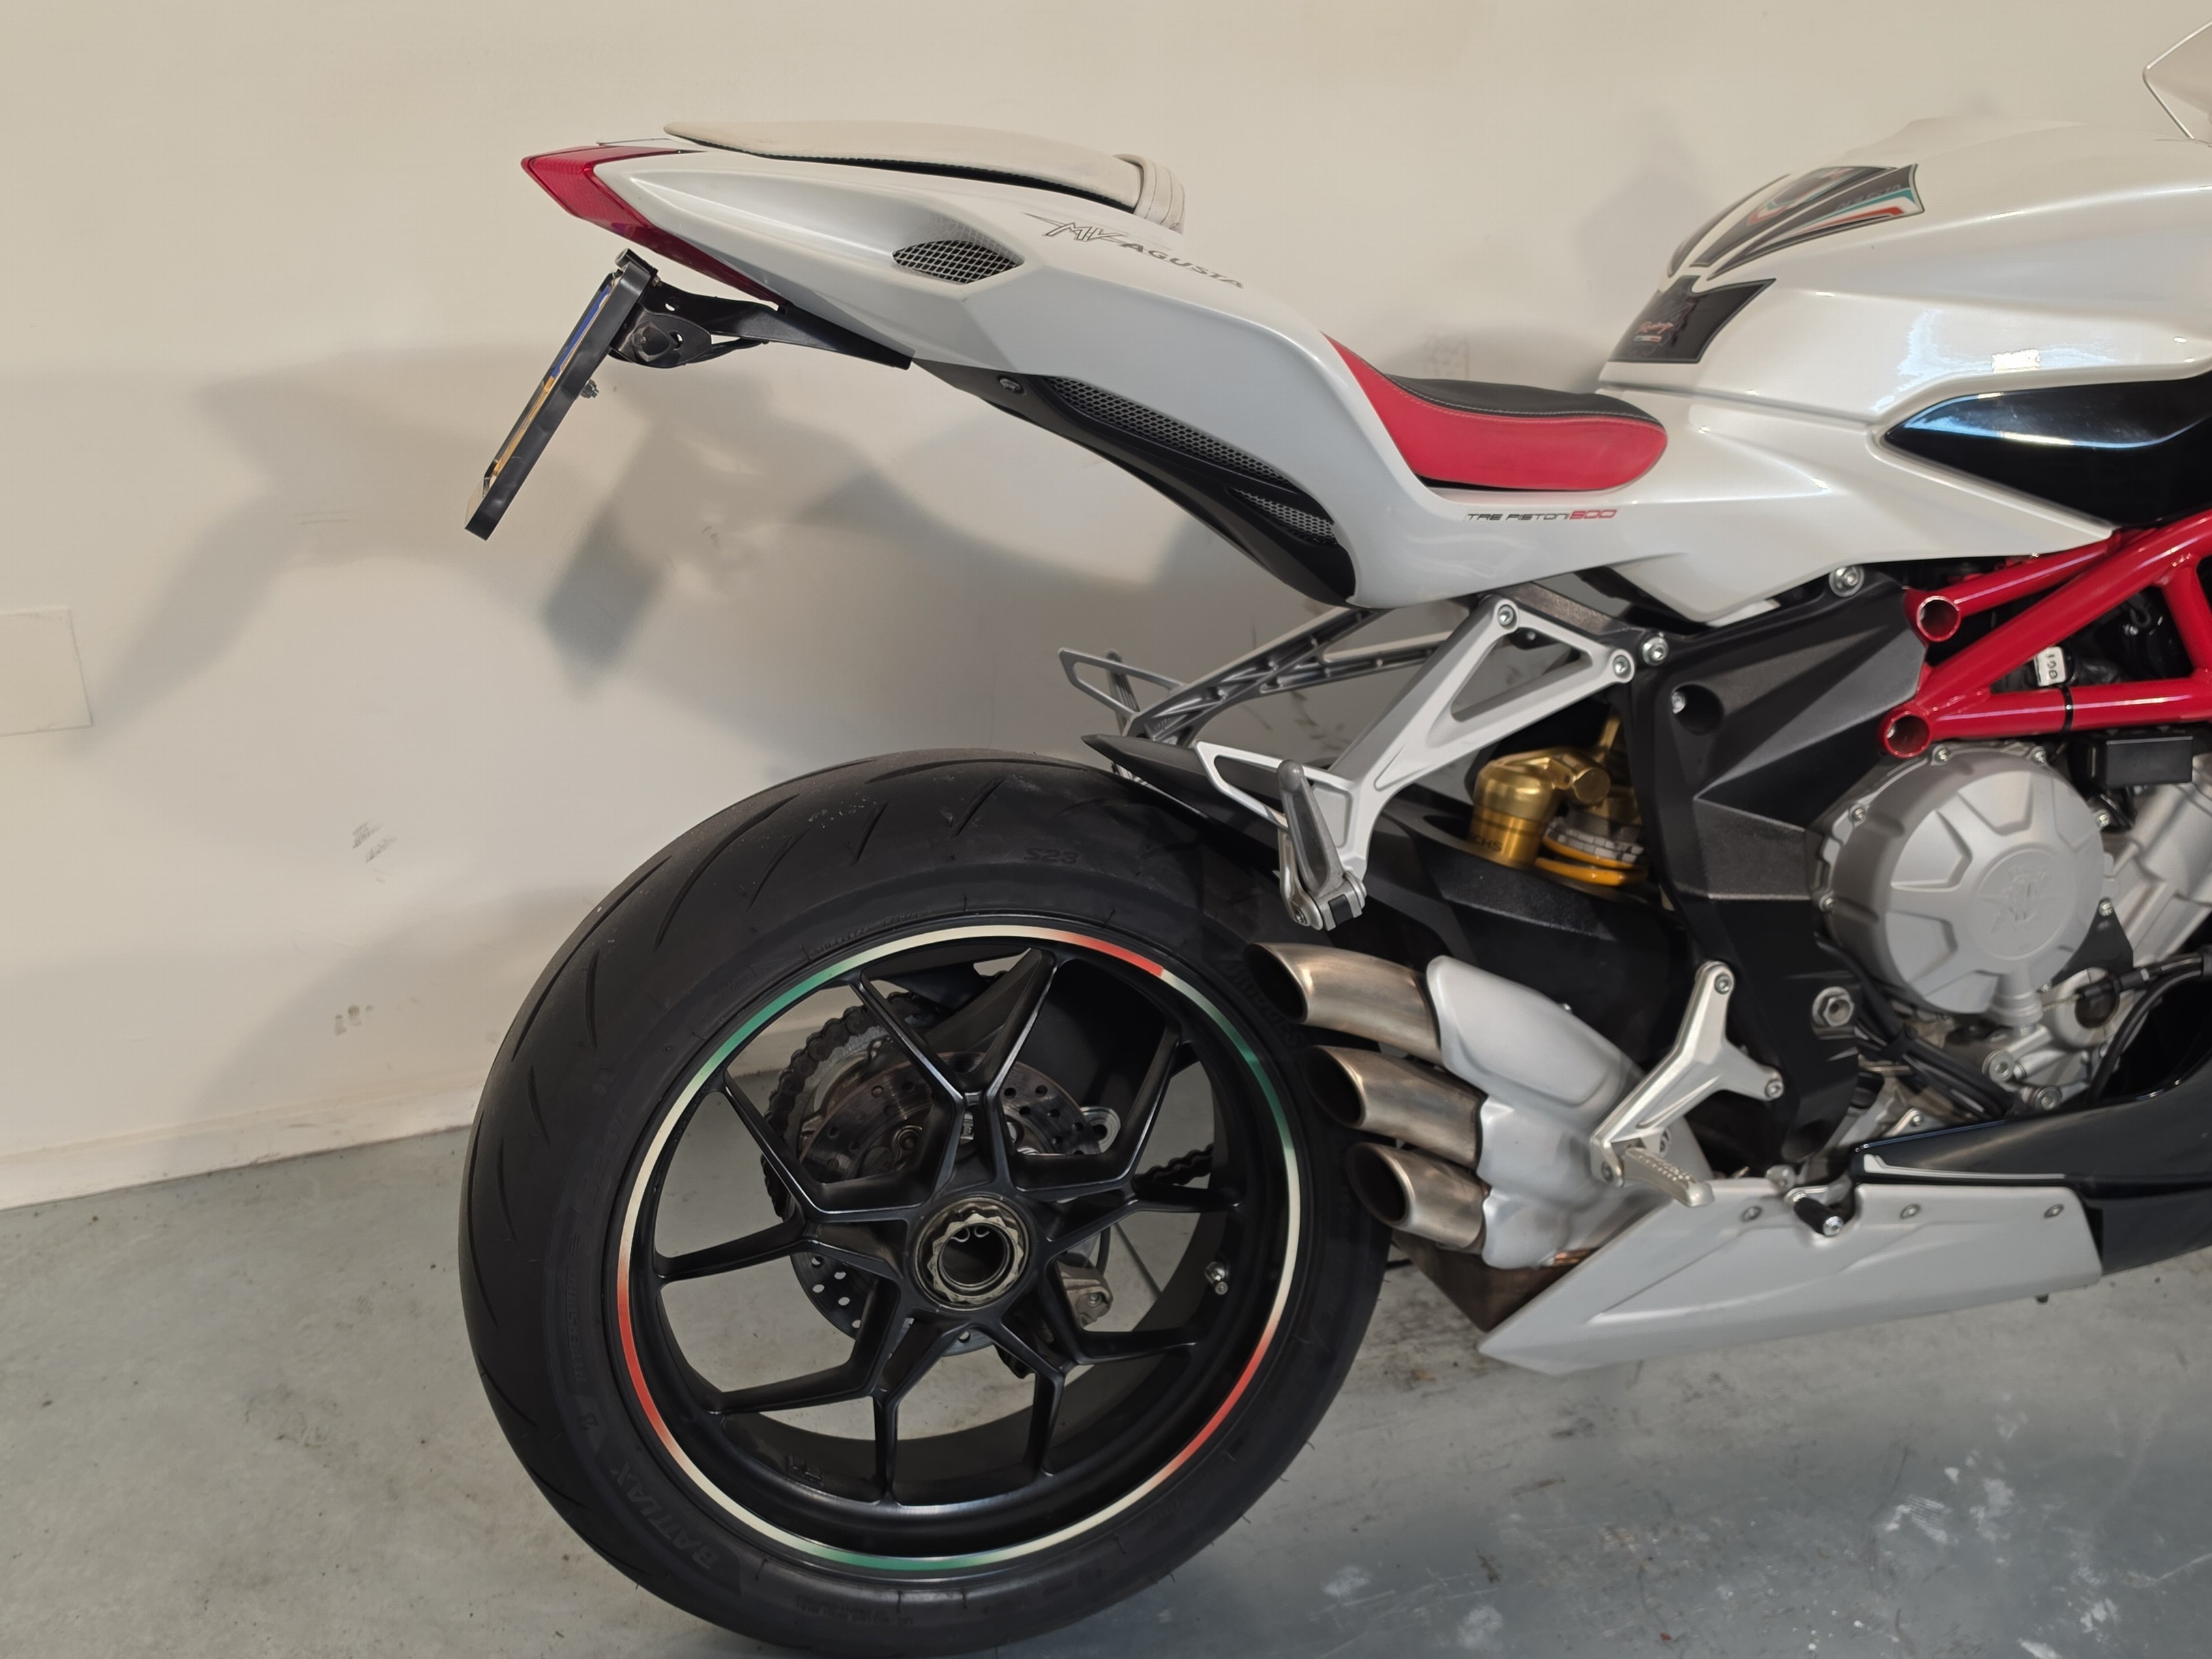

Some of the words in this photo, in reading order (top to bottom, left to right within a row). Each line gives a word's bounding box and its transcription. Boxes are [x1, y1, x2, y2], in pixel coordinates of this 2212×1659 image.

[1026, 214, 1126, 242] MV
[1119, 242, 1243, 289] AGUSTA
[1468, 513, 1503, 521] TRE
[1505, 512, 1570, 521] PISTON
[1569, 509, 1617, 520] 800
[610, 1460, 720, 1570] BATTLAX
